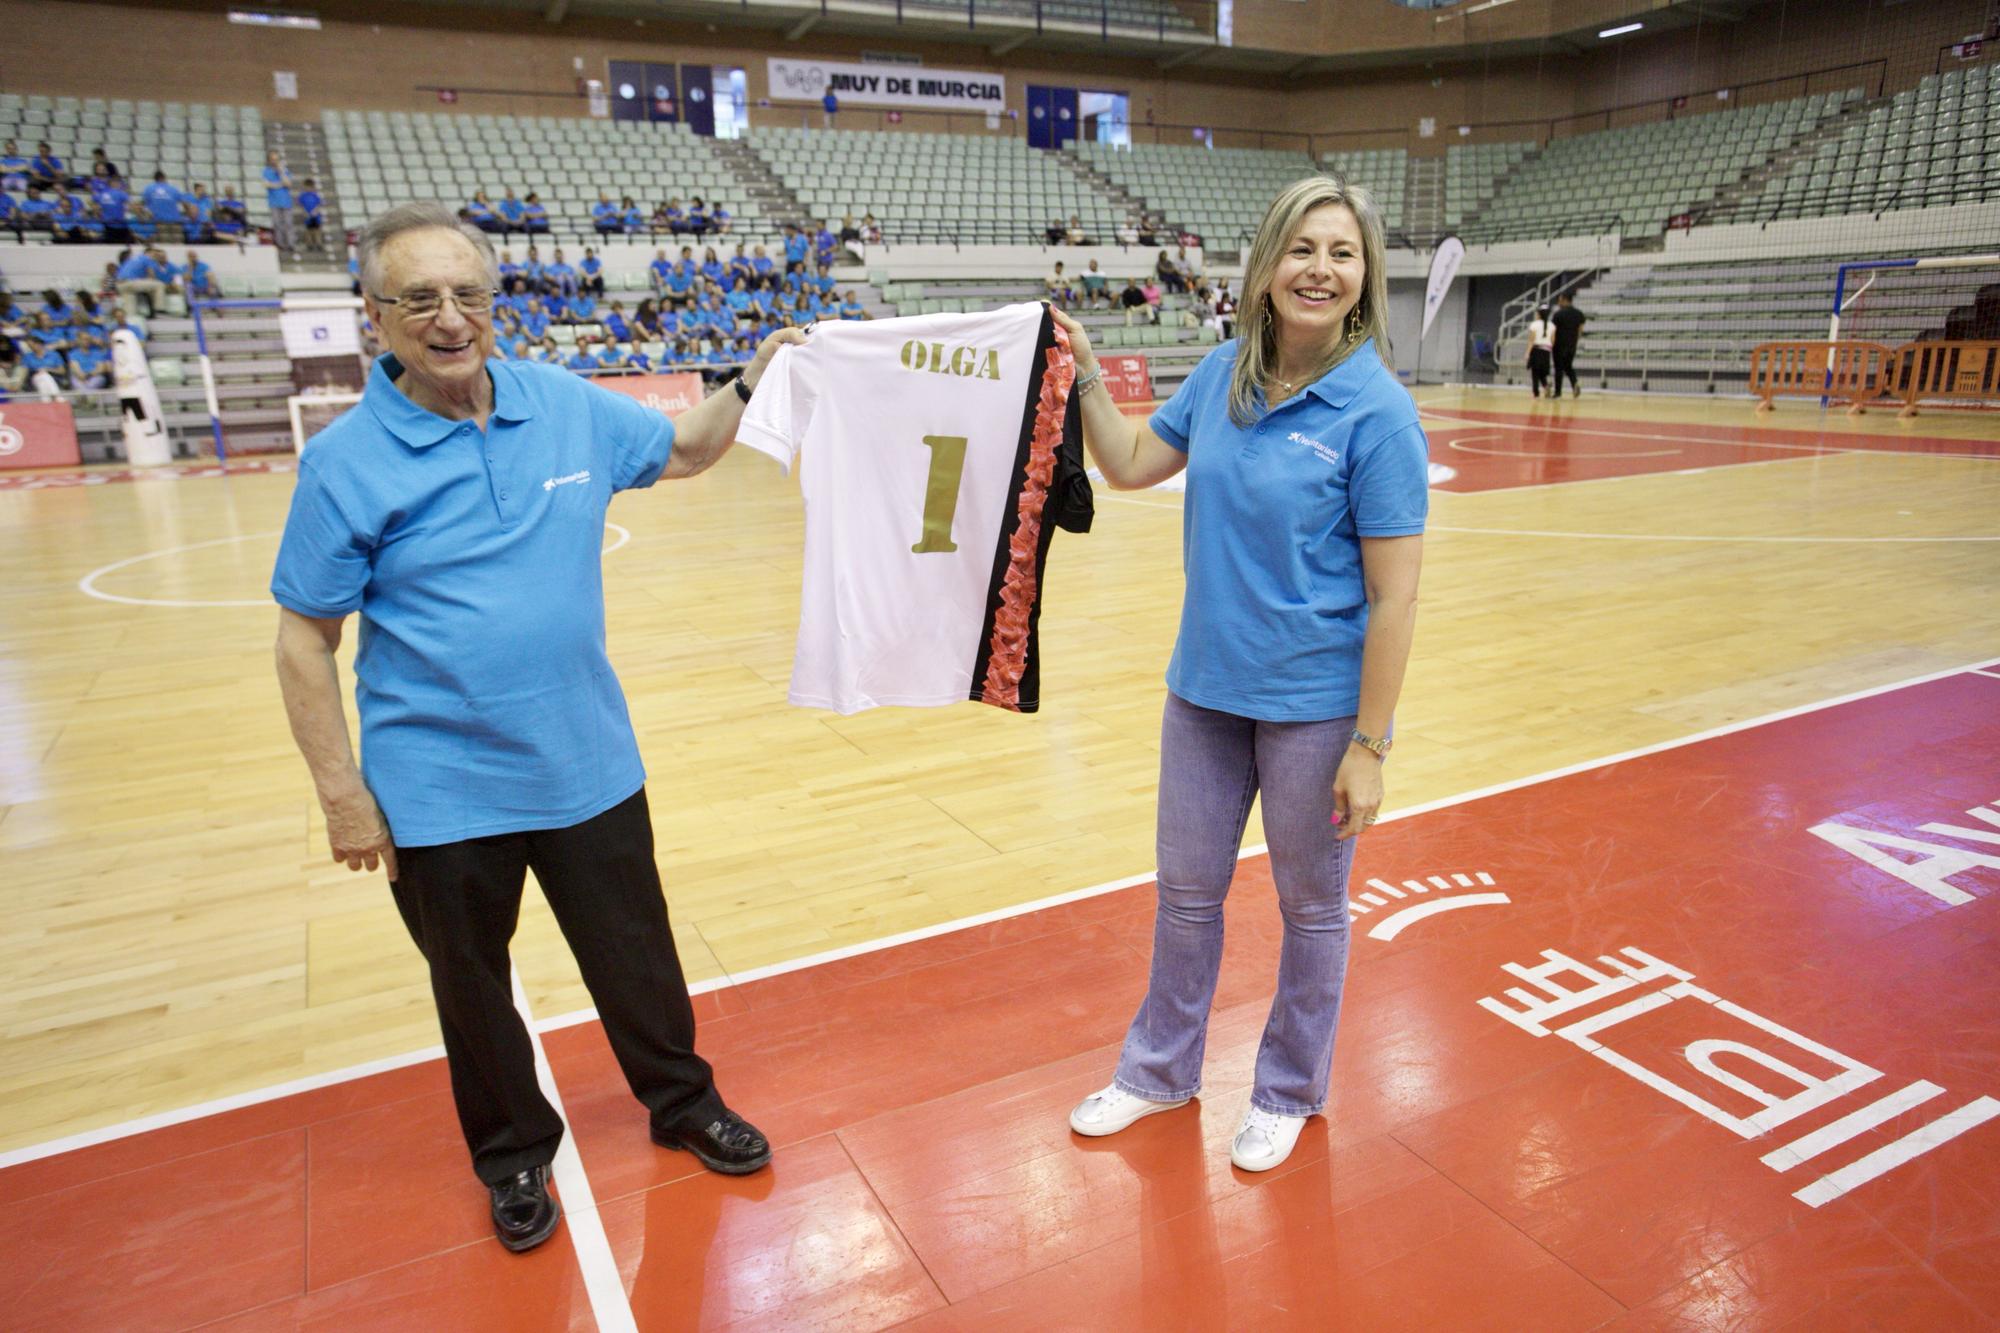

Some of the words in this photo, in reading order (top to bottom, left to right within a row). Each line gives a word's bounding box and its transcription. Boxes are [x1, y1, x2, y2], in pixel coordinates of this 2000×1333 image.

[831, 73, 879, 93] MUY
[886, 77, 912, 95] DE
[918, 80, 1002, 101] MURCIA
[900, 339, 1001, 381] OLGA
[911, 434, 968, 554] 1
